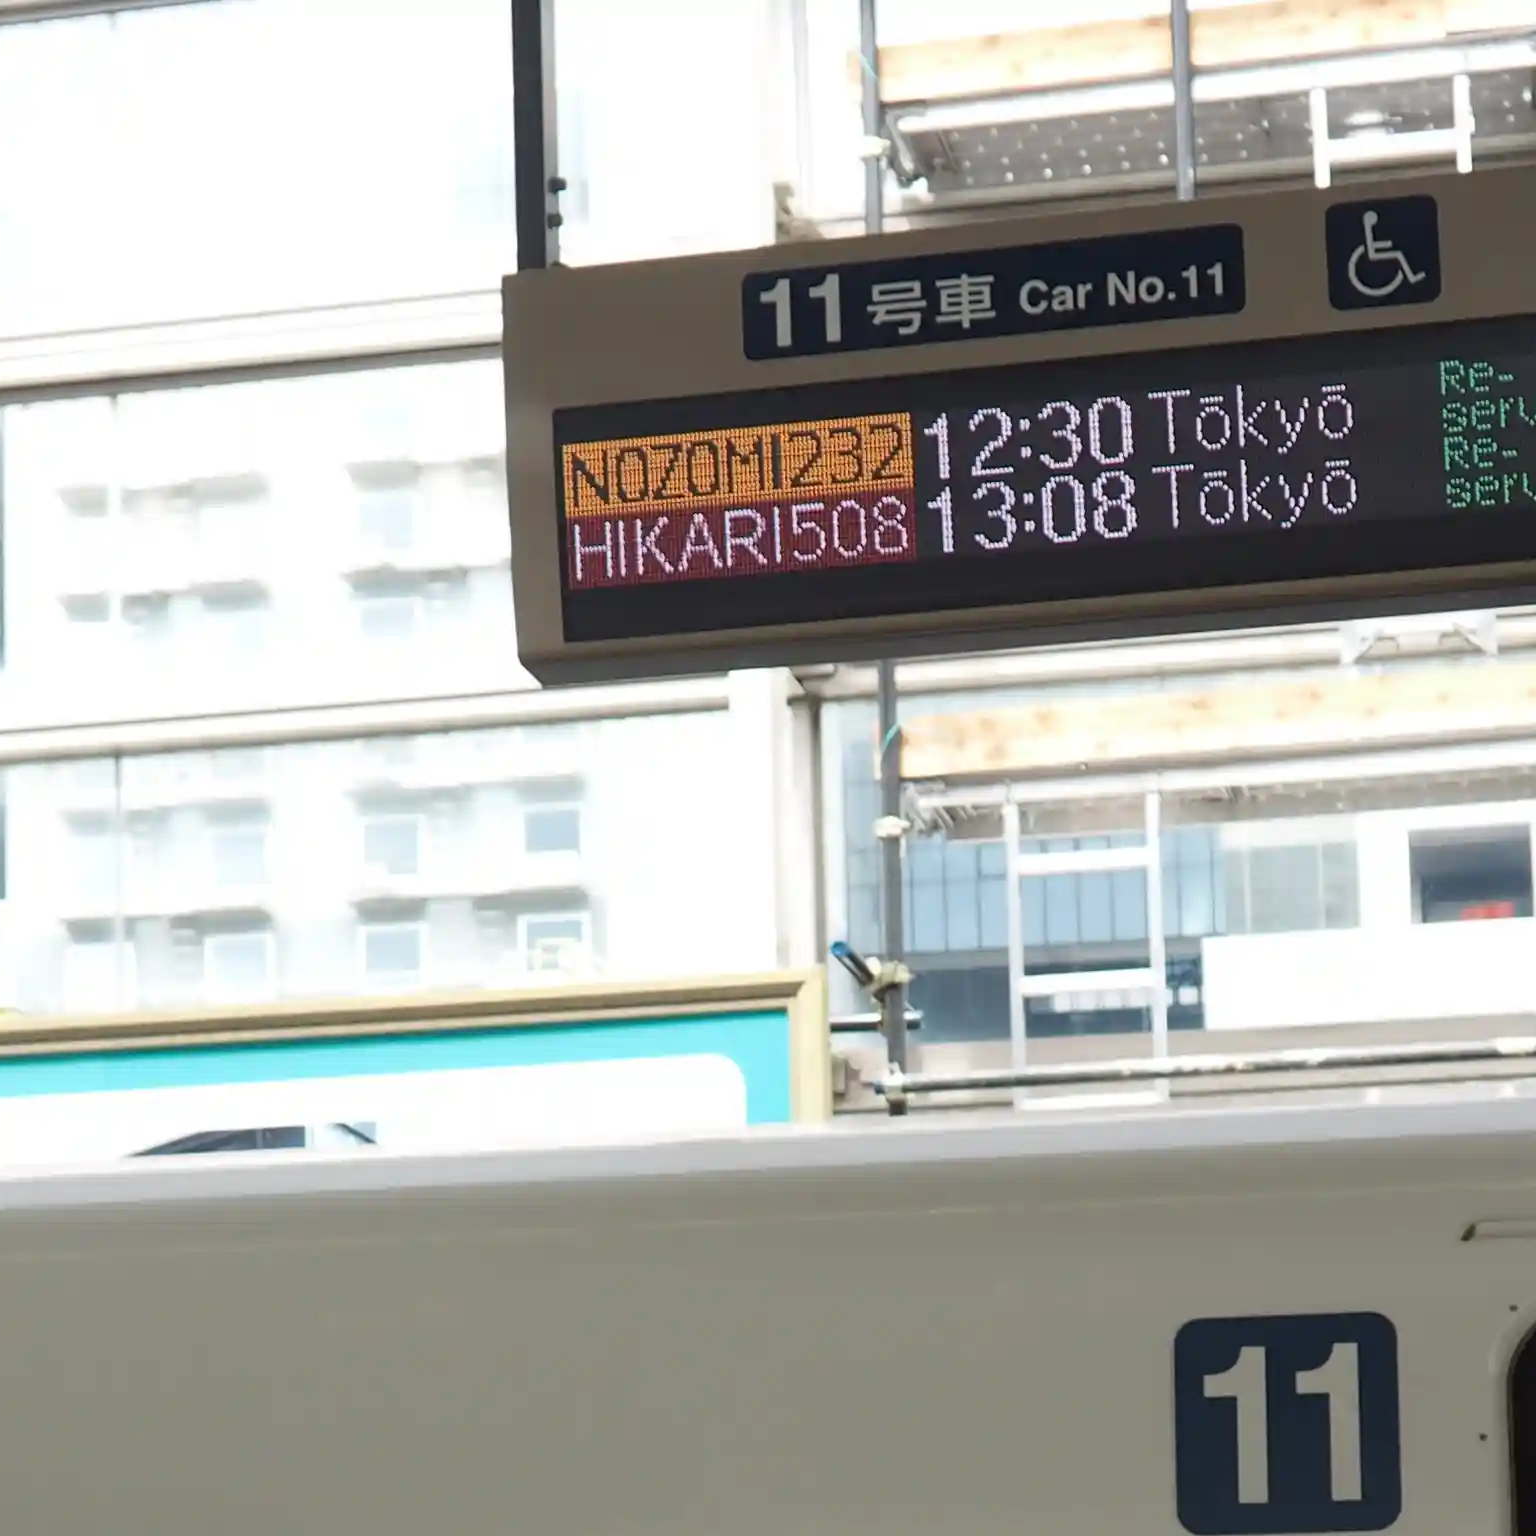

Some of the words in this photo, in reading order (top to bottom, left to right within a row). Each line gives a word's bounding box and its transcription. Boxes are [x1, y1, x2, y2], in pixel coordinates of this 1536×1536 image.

[1019, 277, 1092, 315] Car
[924, 396, 1133, 480] 12:30
[1148, 384, 1353, 454] Tōkyō
[927, 470, 1137, 554] 13:08
[1151, 459, 1357, 529] Tōkyō
[1202, 1342, 1362, 1503] 11
